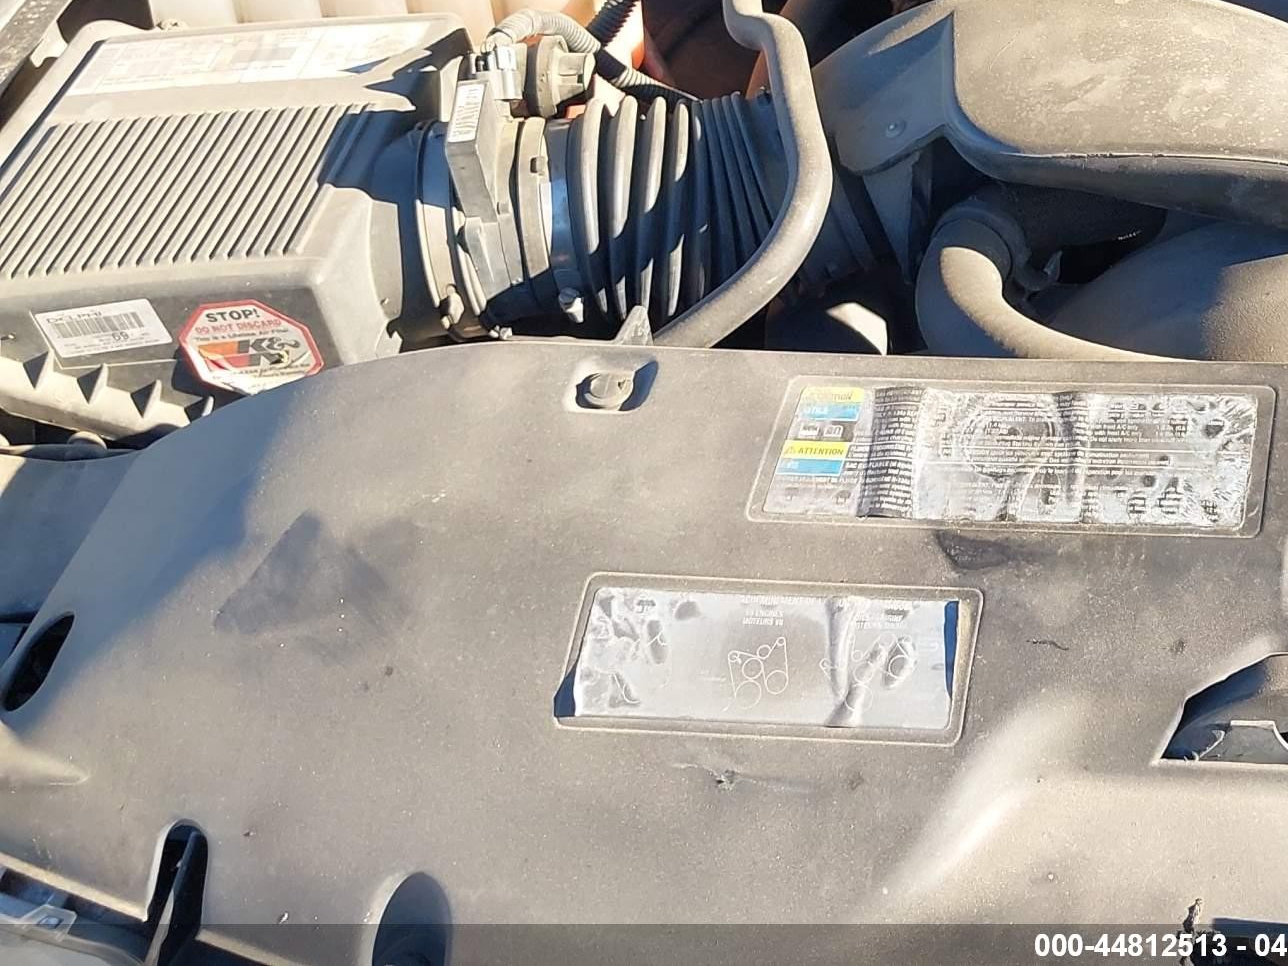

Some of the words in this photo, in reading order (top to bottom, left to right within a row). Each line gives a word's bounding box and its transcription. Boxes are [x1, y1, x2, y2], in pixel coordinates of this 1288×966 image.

[205, 308, 261, 323] STOP!
[195, 326, 210, 336] DO
[211, 322, 236, 334] NOT
[236, 318, 282, 332] DISCARD
[798, 447, 844, 456] ATTENTION
